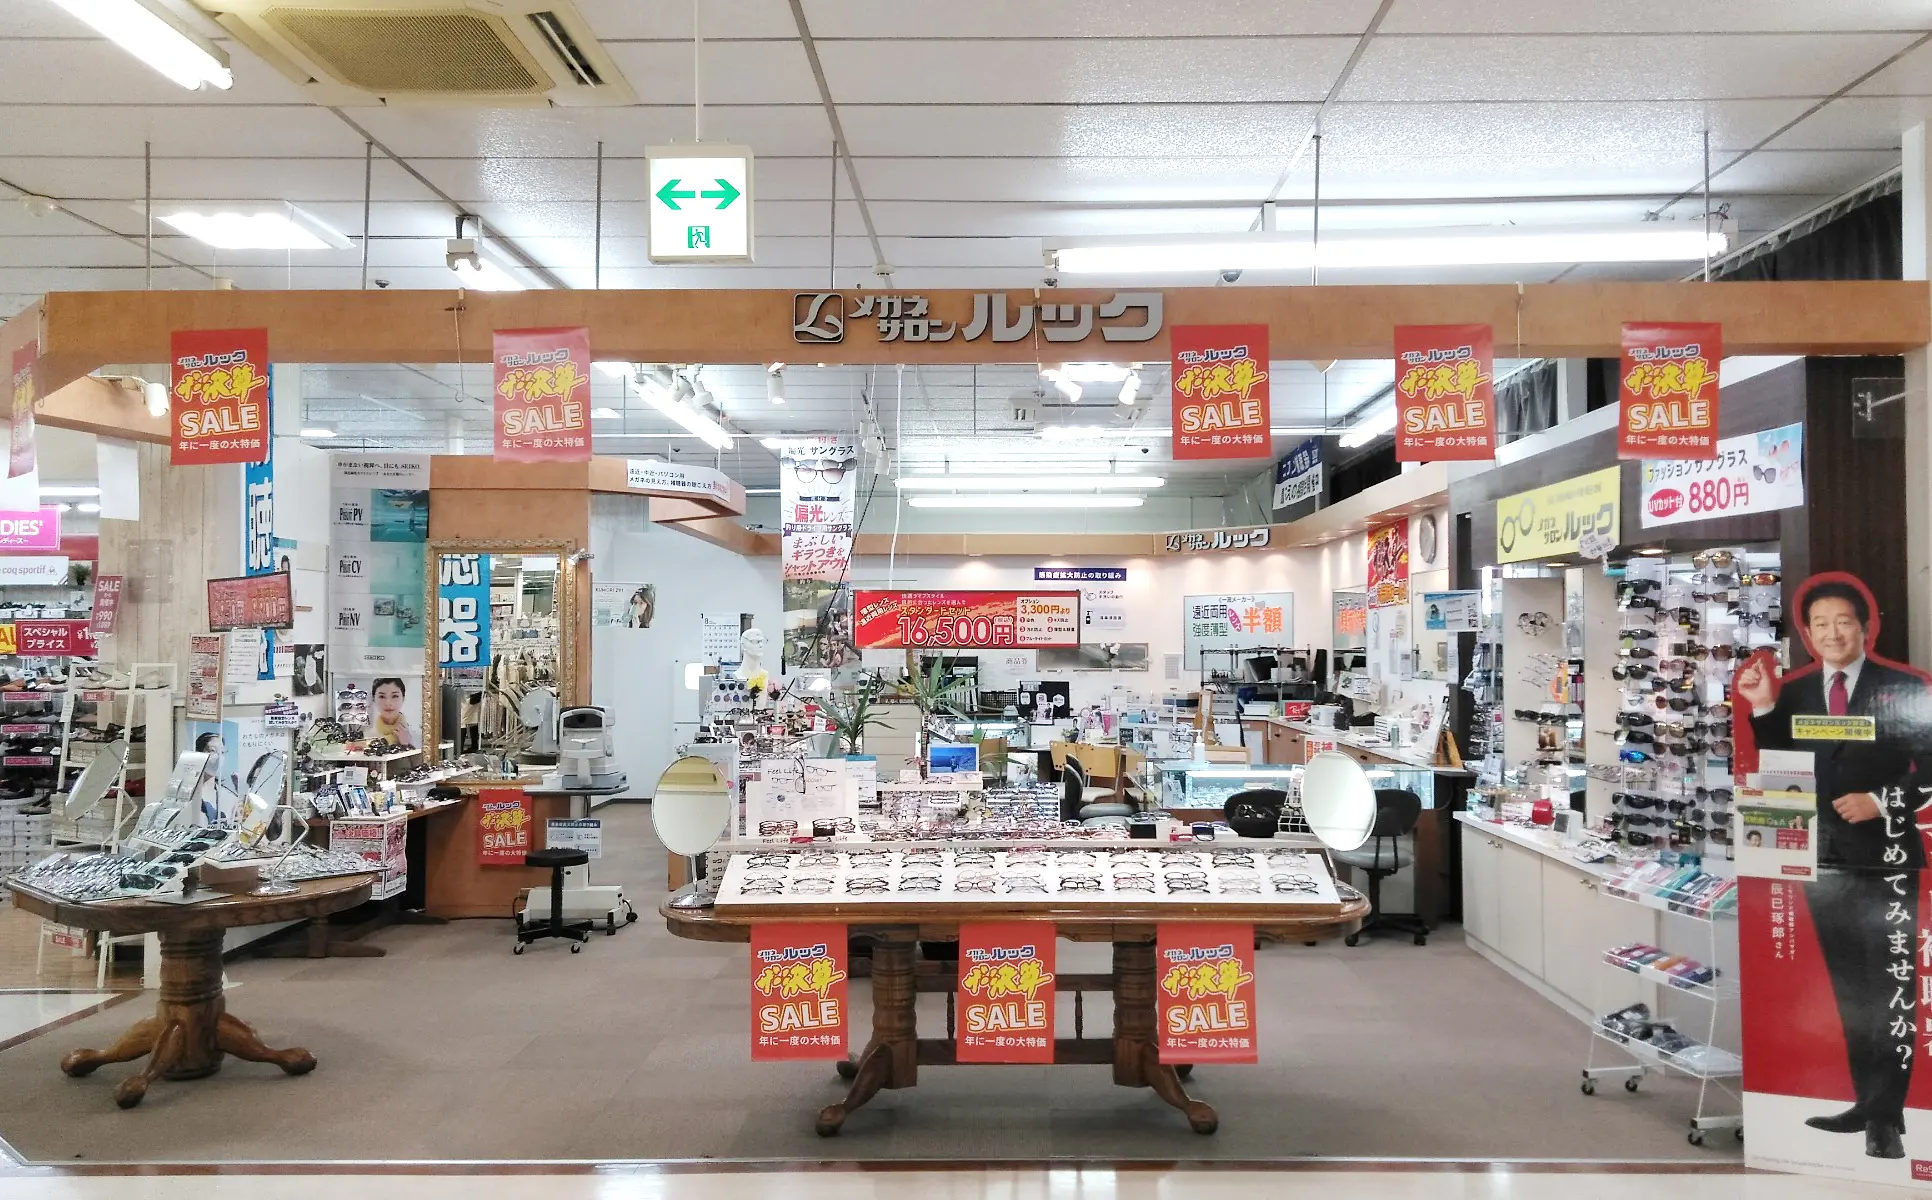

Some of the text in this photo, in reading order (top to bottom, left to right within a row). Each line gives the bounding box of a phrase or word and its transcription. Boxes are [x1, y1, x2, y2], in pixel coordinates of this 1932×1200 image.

[848, 291, 1164, 342] メガネ ルック
[877, 319, 957, 342] サロン
[181, 404, 260, 438] SALE
[503, 402, 583, 436] SALE
[1181, 400, 1261, 433] SALE
[1404, 400, 1486, 434] SALE
[1628, 400, 1710, 432] SALE
[179, 439, 260, 451] 年に一度の大特価
[502, 438, 584, 448] 年に一度の大特価
[1180, 435, 1263, 445] 年に一度の大特価
[1404, 436, 1487, 447] 年に一度の大特価
[1626, 435, 1710, 446] 年に一度の大特価
[1688, 477, 1750, 514] 880円
[1563, 502, 1613, 541] ルック
[792, 534, 844, 549] まぶしい
[1211, 528, 1270, 549] ルック
[792, 547, 845, 561] ギラつきを
[98, 580, 120, 592] SALE
[900, 606, 971, 616] スタンダードセット
[1020, 605, 1070, 615] 3,300円より
[1192, 604, 1227, 620] 遠近両用
[1242, 606, 1283, 634] 半額
[23, 627, 68, 637] スペシャル
[897, 616, 1013, 647] 16,500円
[1192, 622, 1228, 637] 強度薄型
[26, 639, 65, 649] プライス
[1795, 728, 1872, 737] キャンペーン開催中
[483, 830, 527, 849] SALE
[1880, 786, 1917, 1070] はじめてみませんか？
[760, 999, 840, 1033] SALE
[966, 1000, 1046, 1033] SALE
[1166, 1000, 1248, 1035] SALE
[759, 1035, 840, 1046] 年に一度の大特価
[965, 1036, 1046, 1047] 年に一度の大特価
[1167, 1038, 1249, 1048] 年に一度の大特価
